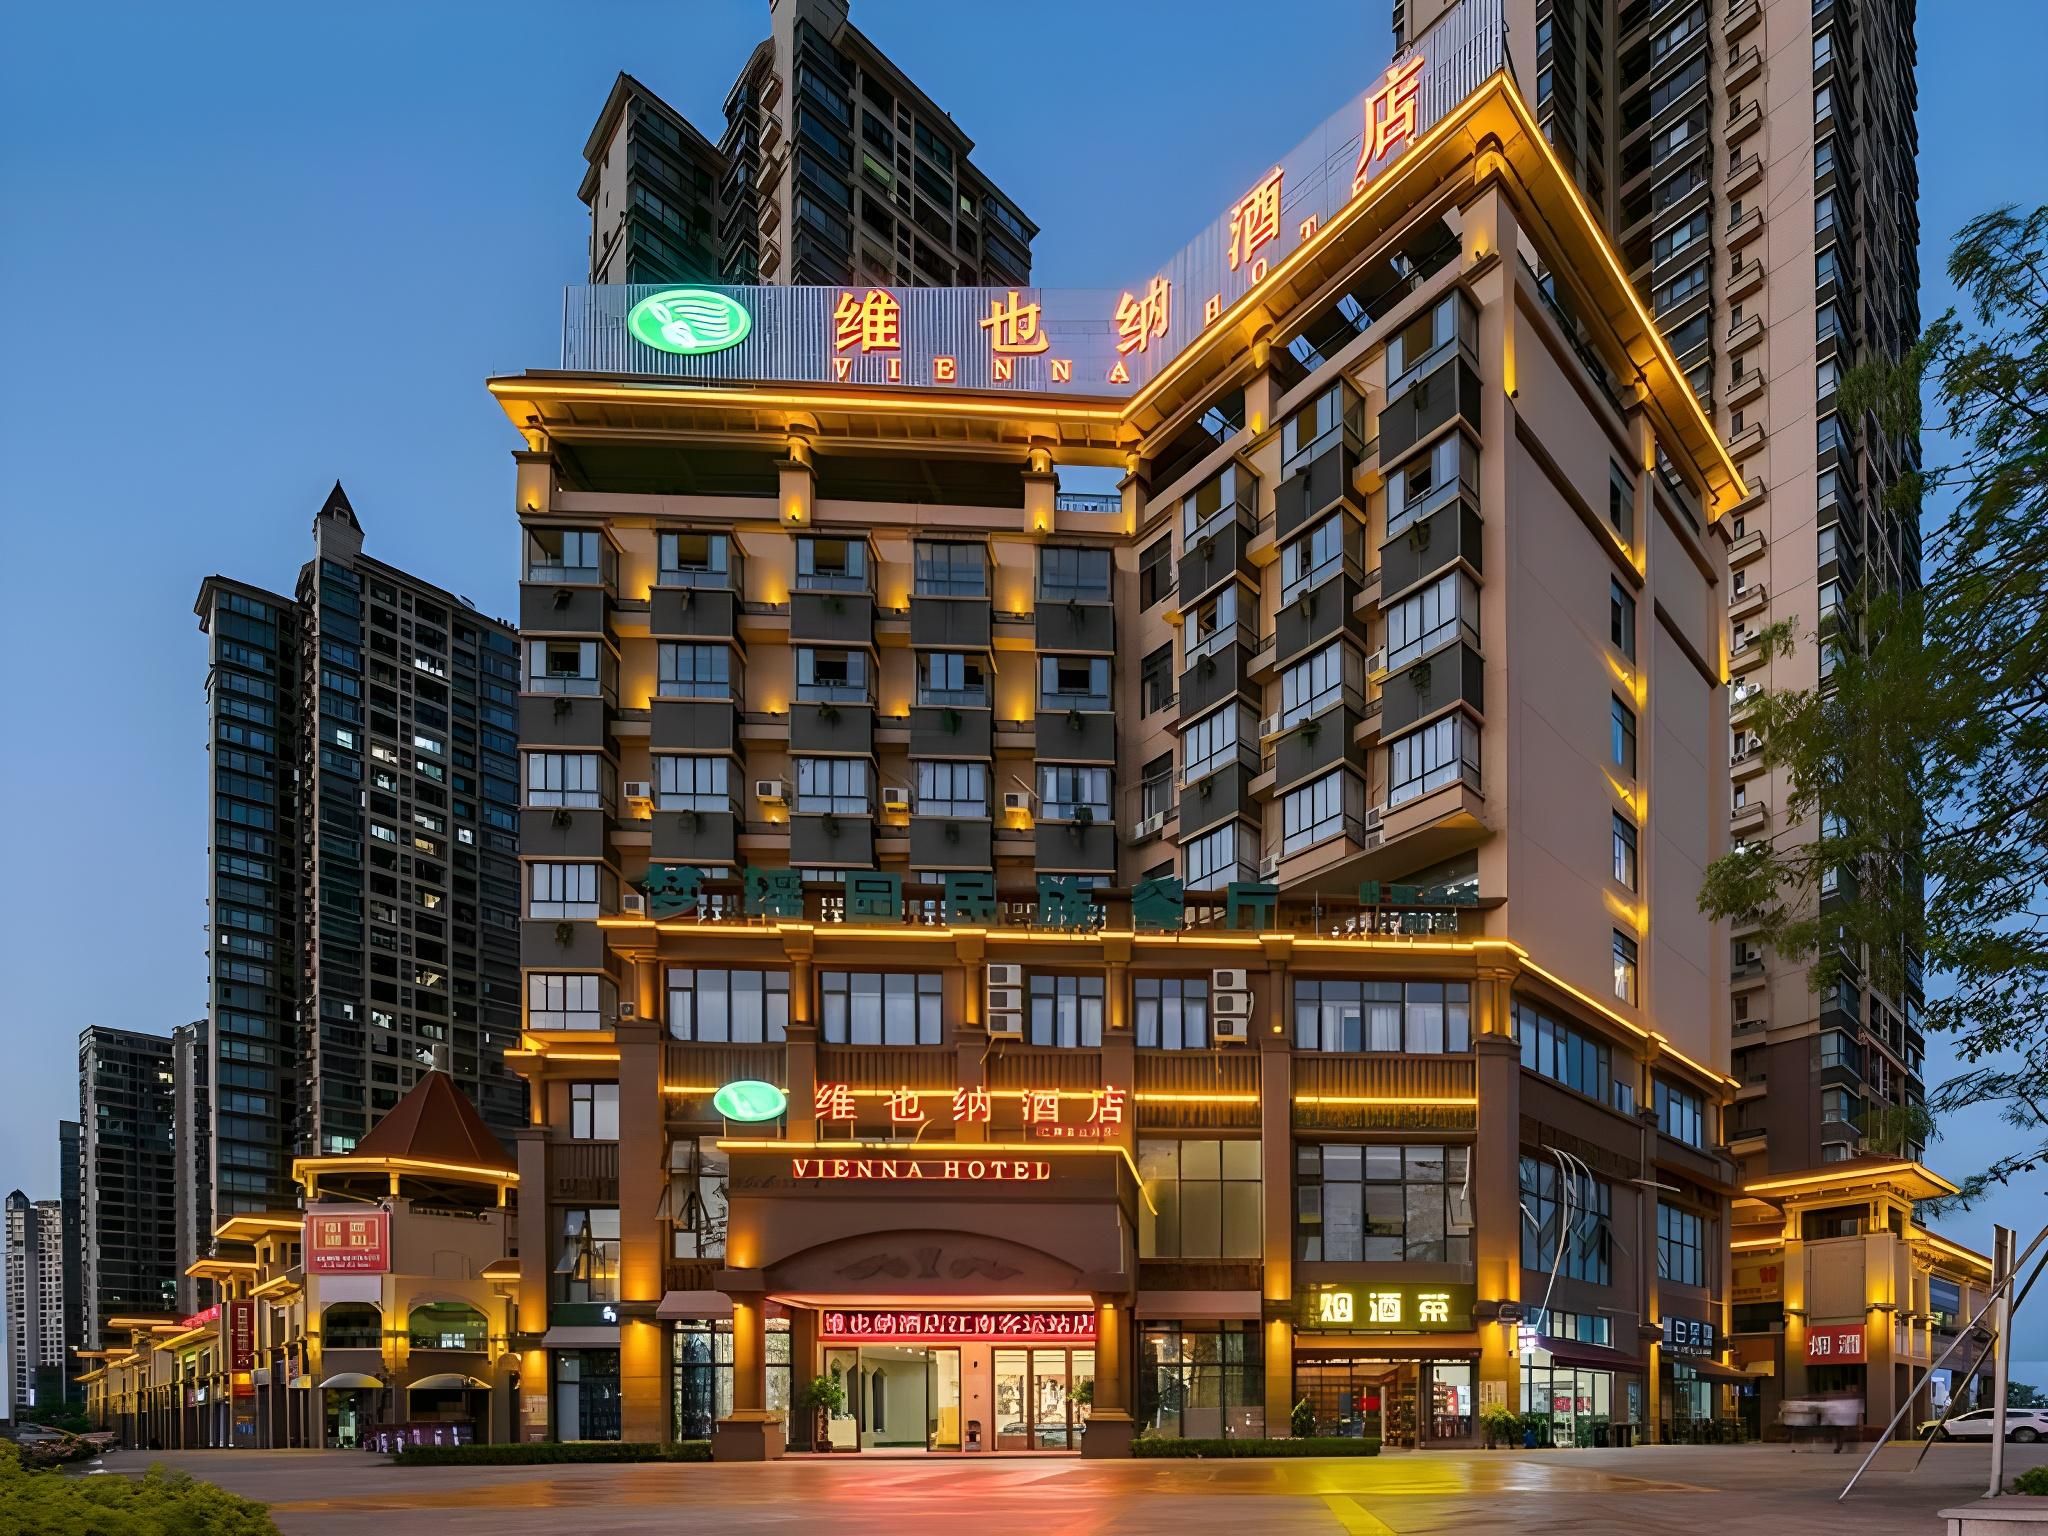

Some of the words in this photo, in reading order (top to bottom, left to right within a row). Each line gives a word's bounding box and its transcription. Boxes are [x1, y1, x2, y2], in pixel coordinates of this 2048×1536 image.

[833, 54, 1425, 353] 维也纳酒店
[833, 357, 1130, 384] VIENNA
[815, 1084, 1126, 1123] 维也纳酒店
[793, 1159, 921, 1179] VIENNA
[944, 1160, 1051, 1180] HOTEL
